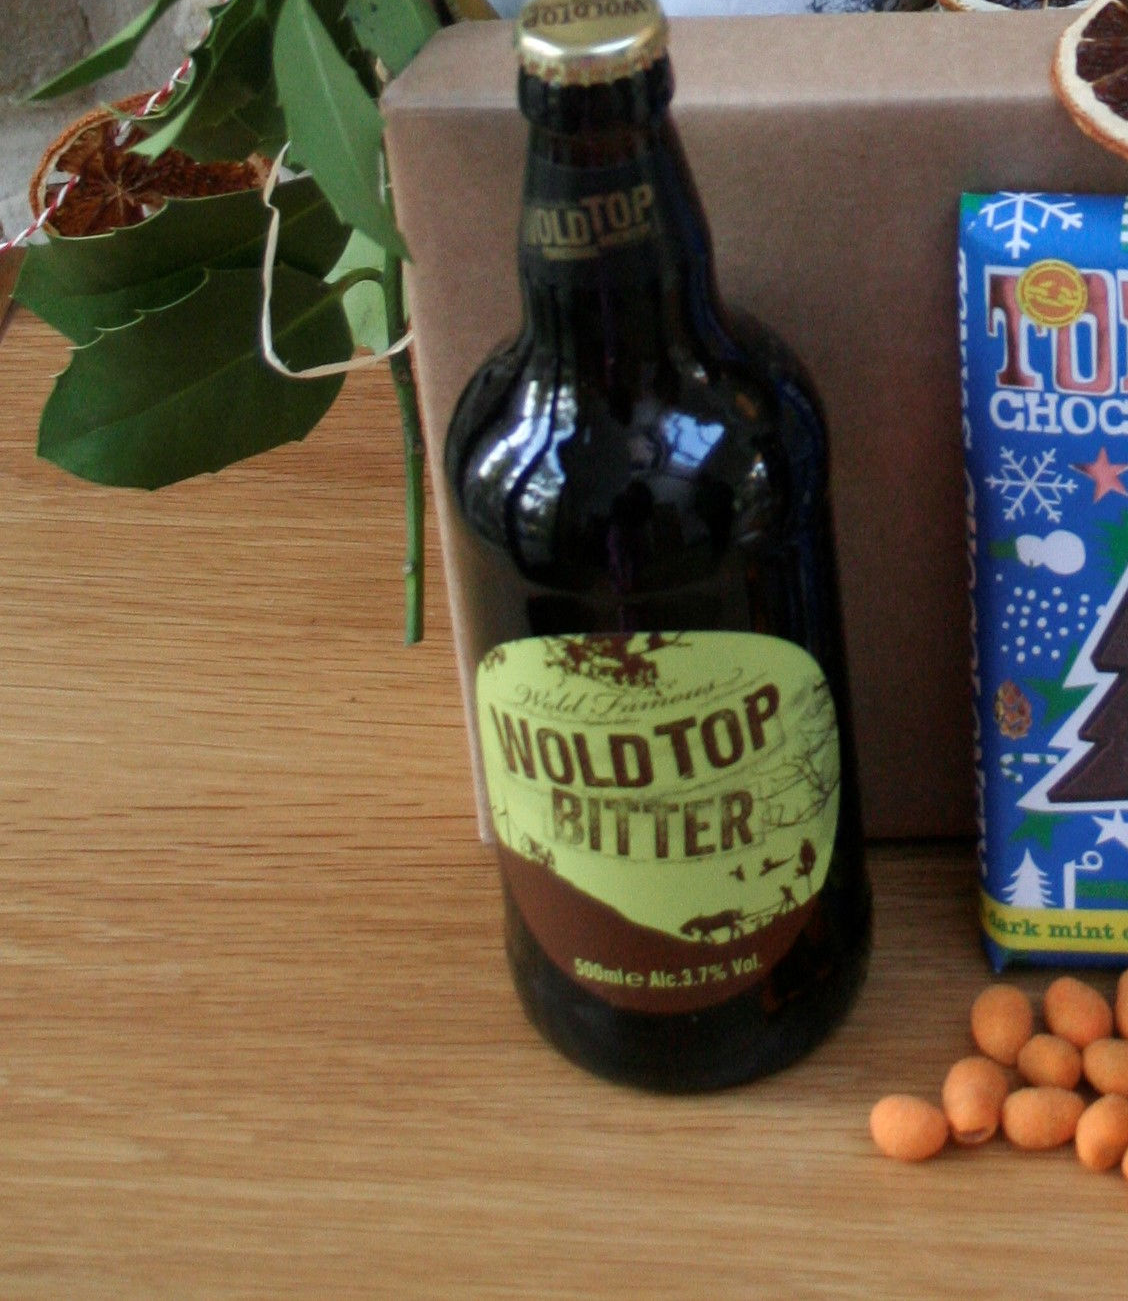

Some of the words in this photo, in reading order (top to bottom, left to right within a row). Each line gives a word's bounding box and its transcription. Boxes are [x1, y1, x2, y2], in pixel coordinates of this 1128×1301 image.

[552, 787, 756, 860] BITTER
[1049, 921, 1115, 941] mint
[574, 957, 624, 986] 500ml
[731, 952, 764, 977] Vol.
